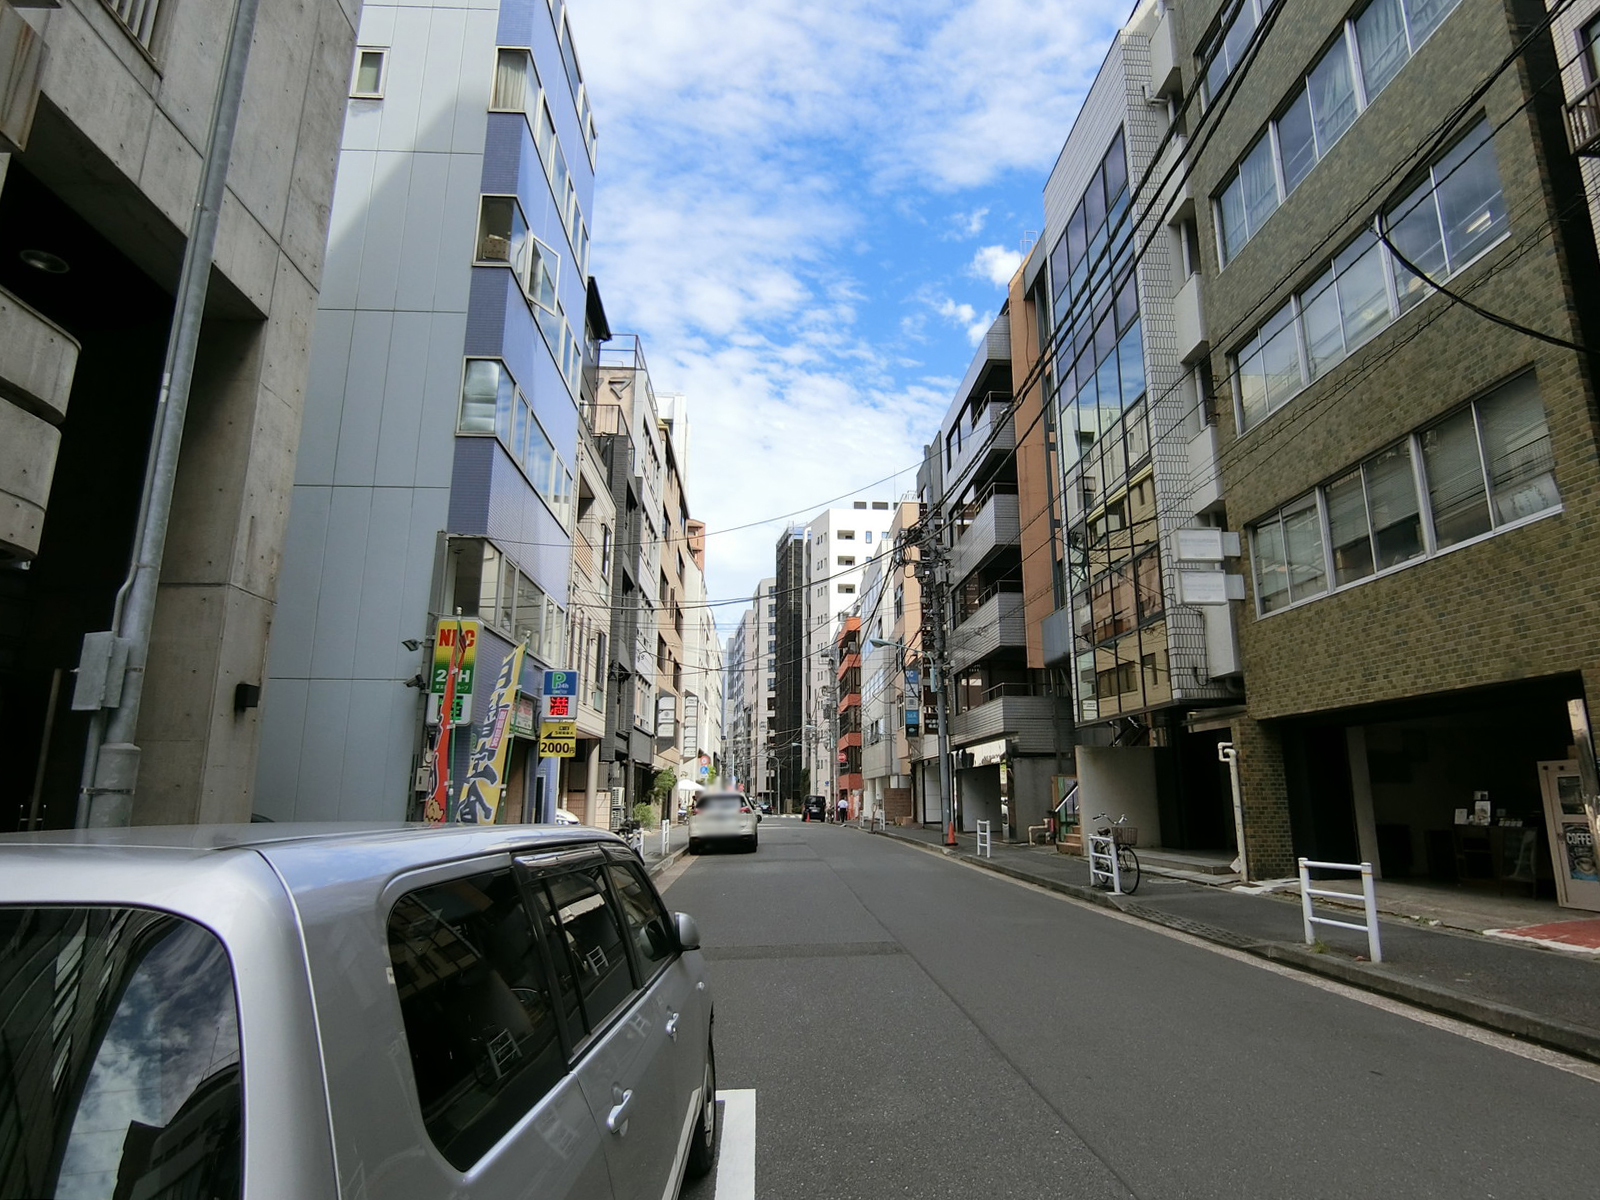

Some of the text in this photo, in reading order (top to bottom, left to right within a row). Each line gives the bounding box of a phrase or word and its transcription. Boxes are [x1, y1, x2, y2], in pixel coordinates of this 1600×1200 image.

[435, 669, 471, 683] 2H
[552, 672, 567, 689] P
[549, 697, 569, 716] 満
[540, 742, 576, 754] 2000円
